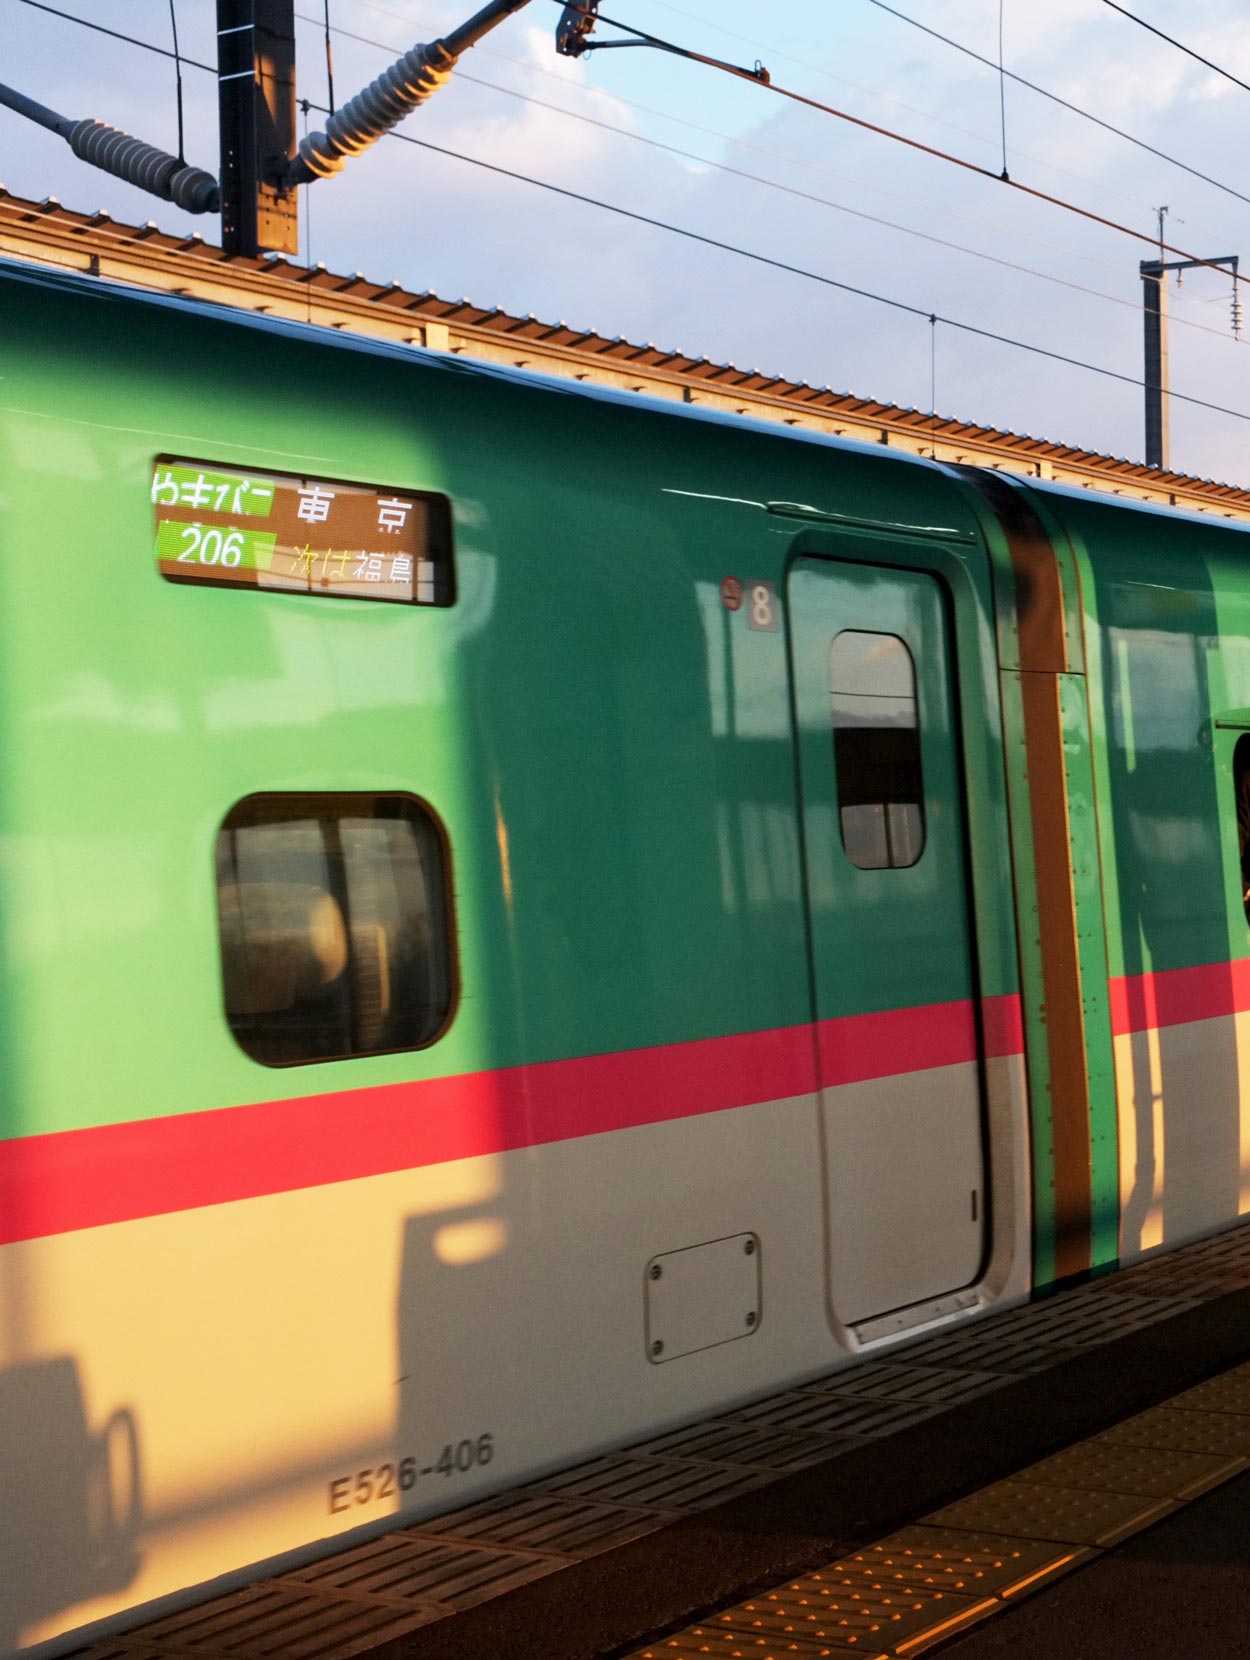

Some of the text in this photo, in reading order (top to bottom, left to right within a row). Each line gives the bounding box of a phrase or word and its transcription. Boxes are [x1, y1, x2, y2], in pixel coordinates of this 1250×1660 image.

[177, 525, 245, 568] 206
[752, 585, 772, 625] 8
[328, 1432, 495, 1515] E526-406
